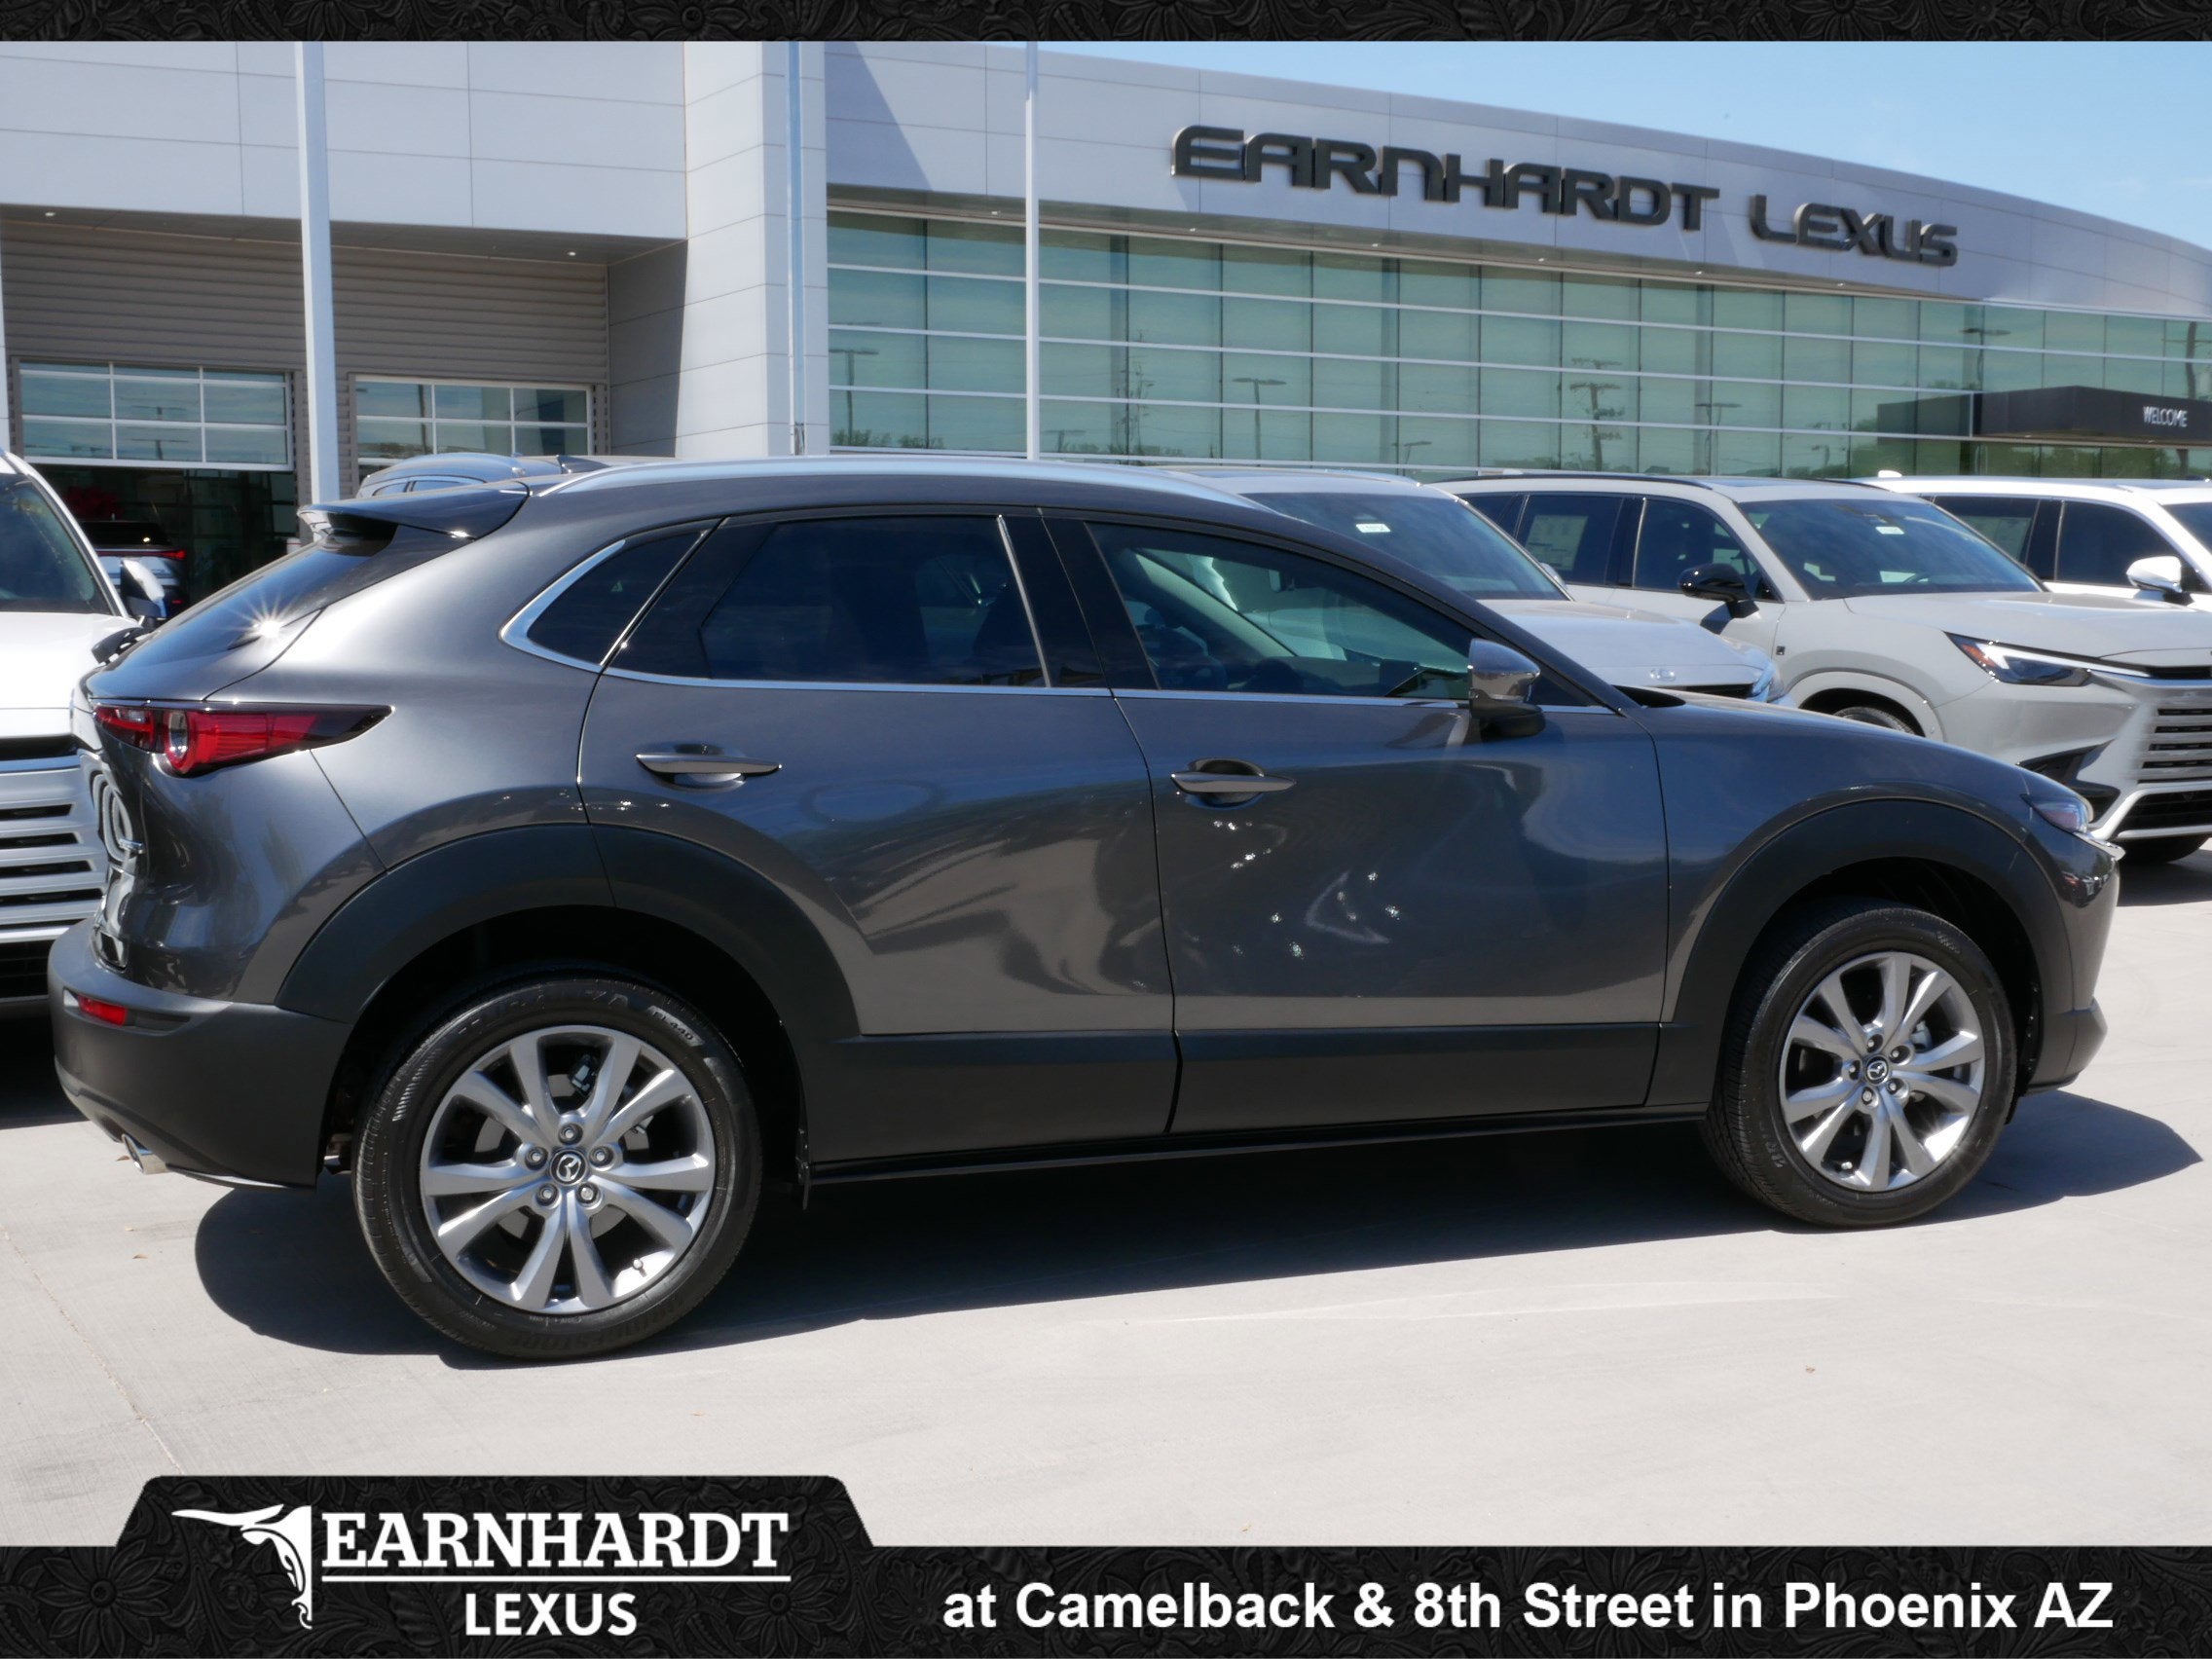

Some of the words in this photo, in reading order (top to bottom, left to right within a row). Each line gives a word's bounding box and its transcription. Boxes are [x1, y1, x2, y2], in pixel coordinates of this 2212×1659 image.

[1171, 125, 1719, 231] EARNHARDT
[1750, 194, 1957, 267] LEXUS
[2143, 406, 2188, 427] WELCOME
